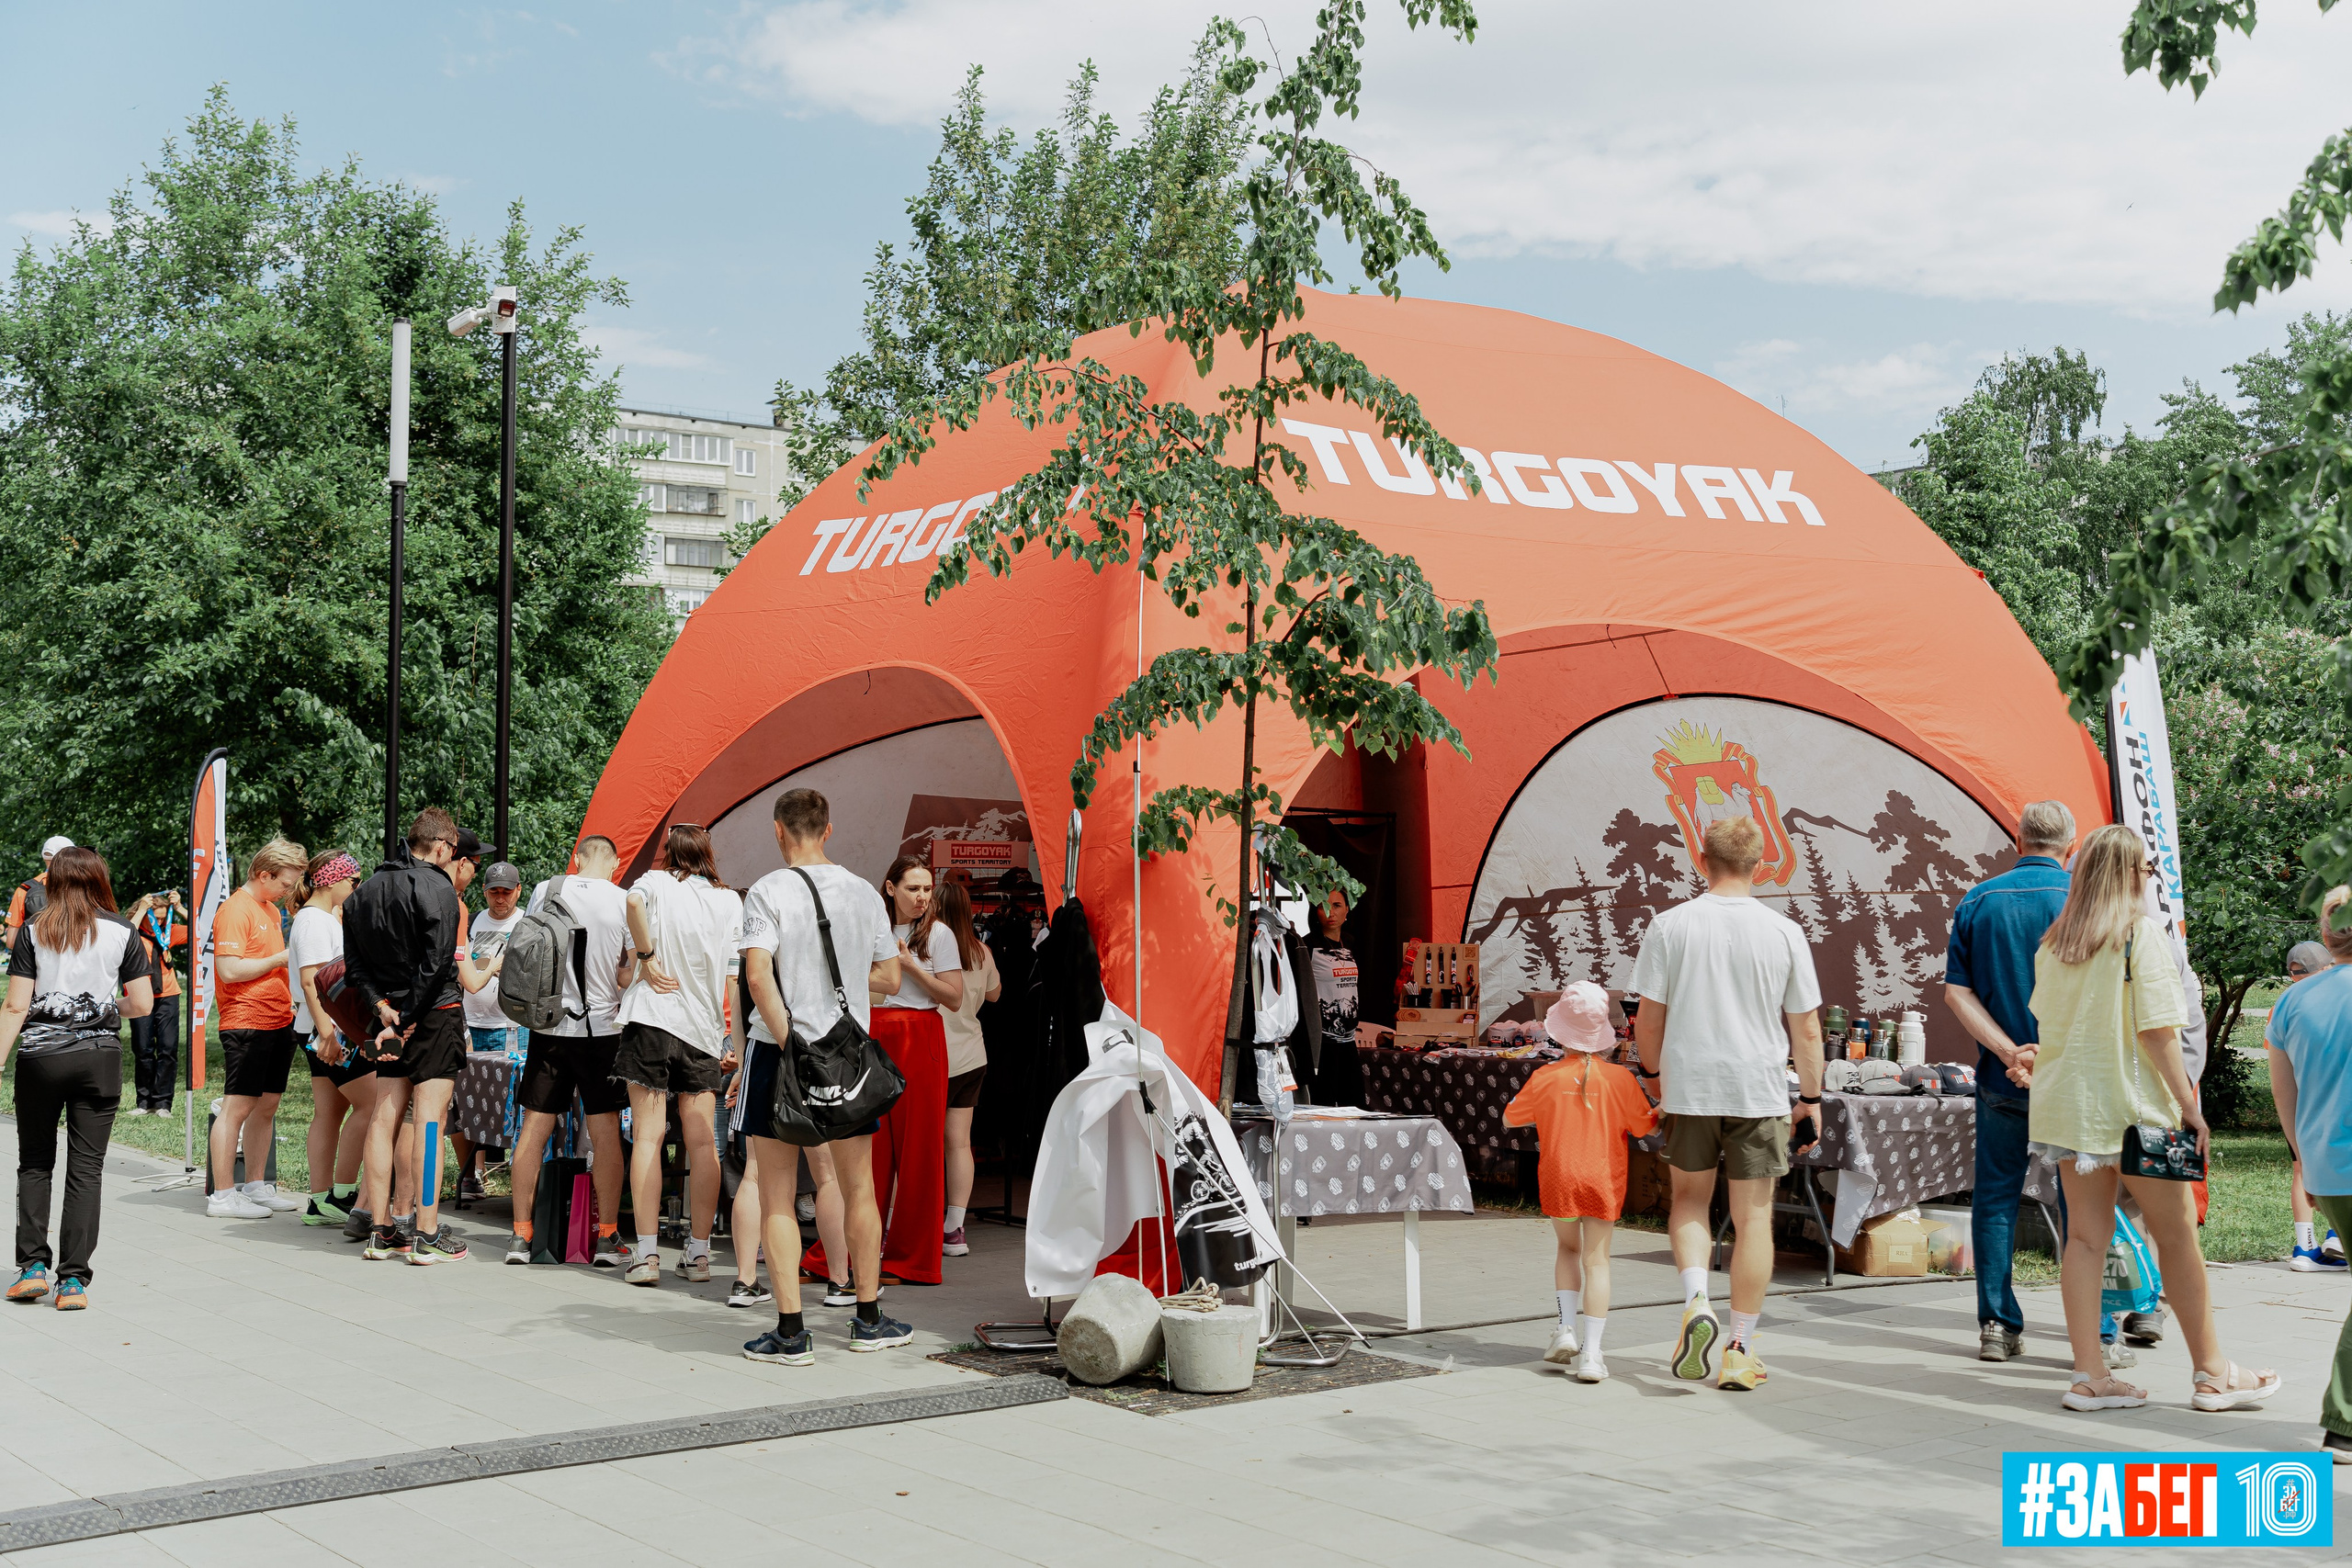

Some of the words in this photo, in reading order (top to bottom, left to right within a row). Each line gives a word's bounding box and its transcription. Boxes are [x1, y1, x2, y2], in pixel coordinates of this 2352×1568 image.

[1281, 418, 1826, 527] TURGOYAK
[951, 845, 1012, 857] TURGOYAK
[2125, 736, 2176, 941] АРАФОН
[2138, 731, 2184, 899] КАРАБАШ
